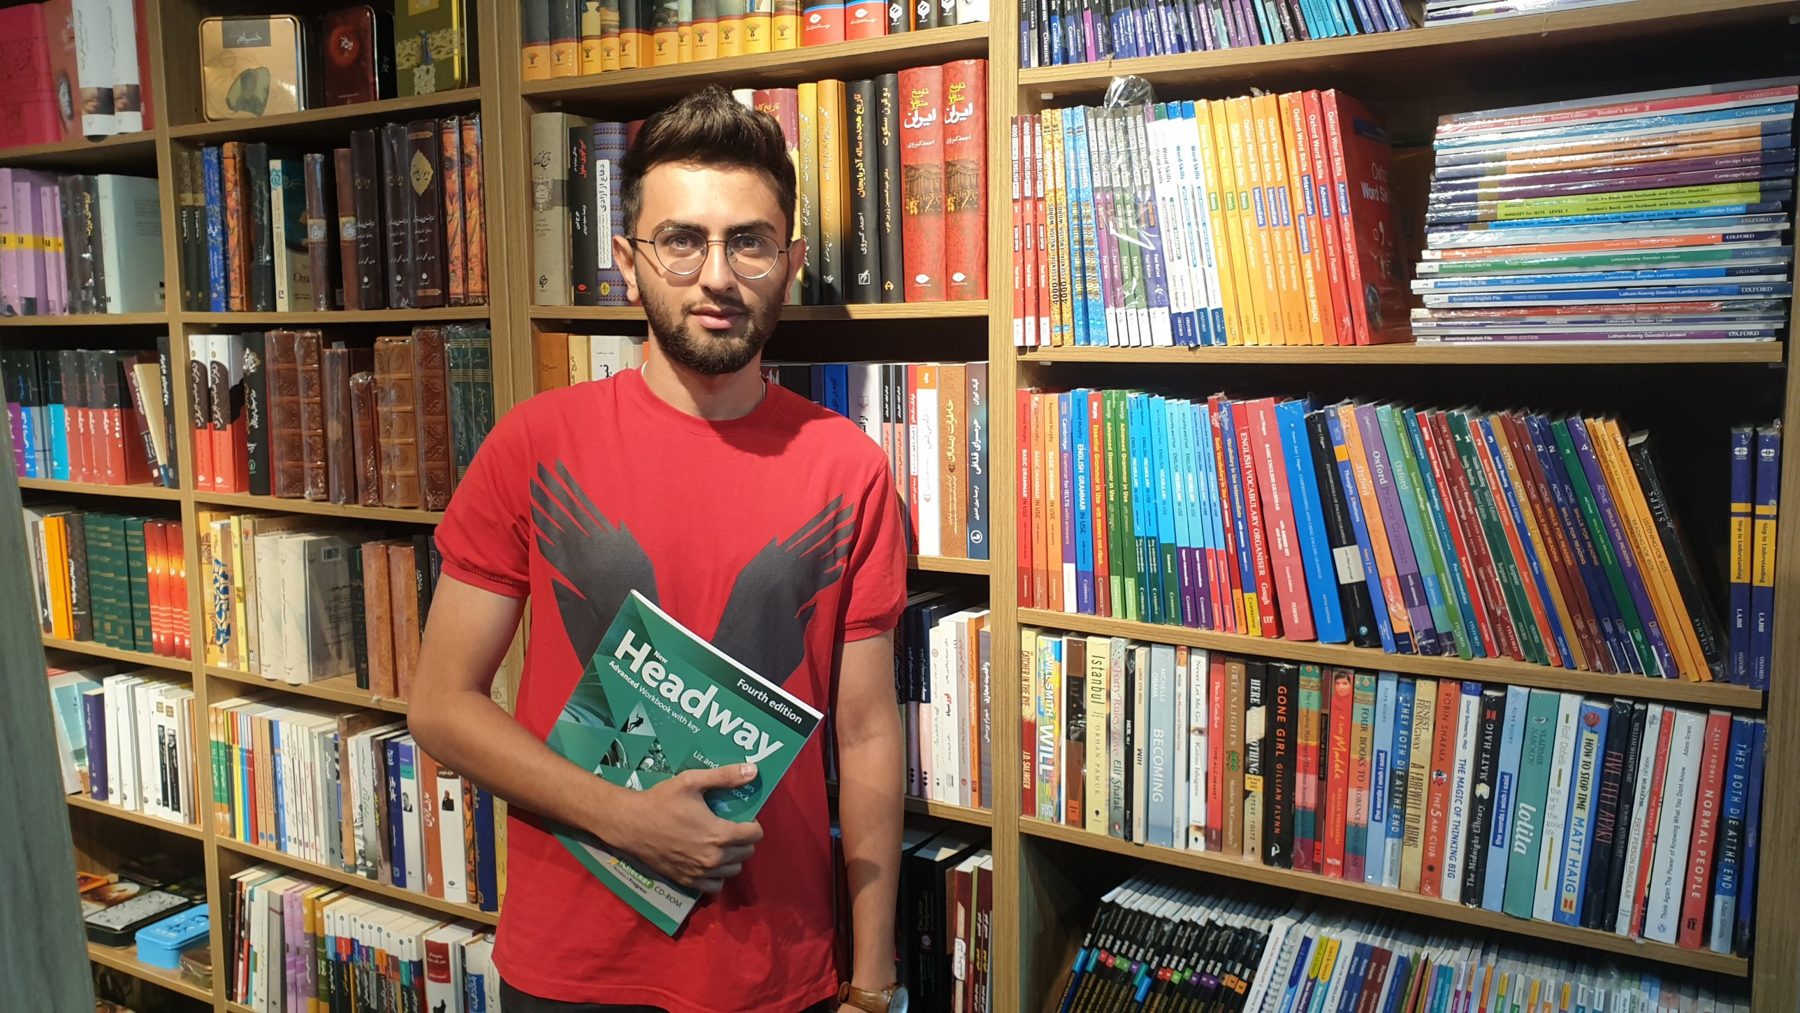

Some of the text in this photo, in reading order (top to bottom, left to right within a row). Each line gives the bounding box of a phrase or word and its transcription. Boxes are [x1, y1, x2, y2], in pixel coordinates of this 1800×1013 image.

[854, 94, 866, 114] تاریخ
[904, 107, 937, 128] ایران
[944, 101, 974, 124] ایران
[600, 164, 608, 182] دفاع
[854, 159, 866, 198] آذربایجان
[1294, 108, 1314, 215] Oxford Word Skills Intermediate
[1310, 114, 1329, 216] Oxford Word Skills Advanced
[1279, 188, 1290, 224] Intermediate
[1094, 454, 1102, 484] Grammar
[1581, 444, 1588, 452] 4
[1356, 466, 1370, 496] Oxford
[1394, 460, 1408, 490] Oxford
[1240, 432, 1266, 576] ENGLISH VOCABULARY ORGANISER
[1561, 506, 1572, 525] SKILLS
[1541, 524, 1550, 536] FOR
[1546, 538, 1559, 562] READING
[1566, 526, 1576, 538] FOR
[1573, 540, 1586, 565] READING
[1606, 508, 1616, 528] SKILLS
[1612, 528, 1620, 540] FOR
[1617, 542, 1632, 567] READING
[1643, 518, 1668, 573] LISTENING FOR IELTS
[1260, 582, 1270, 605] Gough
[654, 649, 668, 664] New
[609, 660, 701, 734] Advanced Workbook with key
[614, 628, 784, 763] Headway
[737, 678, 802, 724] Fourth edition
[1044, 656, 1054, 717] WILL SMITH
[1091, 654, 1106, 706] Istanbul
[1152, 672, 1160, 698] OBAMA
[1230, 665, 1240, 746] GREENLIGHTS
[1402, 703, 1410, 725] THEY
[1412, 699, 1424, 750] HEMINGWAY
[1421, 700, 1431, 732] ERNEST
[1438, 692, 1452, 761] ROBIN SHARMA
[693, 750, 720, 769] Liz and
[1040, 724, 1054, 777] WILL
[1274, 686, 1287, 834] GONE GIRL GILLIAN FLYNN
[1398, 730, 1408, 755] BOTH
[1480, 723, 1494, 780] MATT HAIG
[1112, 760, 1123, 811] Elif Shafak
[1152, 728, 1164, 802] BECOMING
[1354, 707, 1369, 823] FOUR BOOKS TO FLORENCE
[1394, 780, 1402, 792] AT
[1396, 760, 1406, 775] DIE
[1576, 738, 1594, 812] HOW TO STOP TIME
[1392, 792, 1402, 809] THE
[1448, 758, 1466, 878] THE MAGIC OF THINKING BIG
[1596, 750, 1624, 844] FIVE FEET APART
[1722, 743, 1746, 889] THEY BOTH DIE AT THE END
[1391, 814, 1400, 833] END
[1428, 792, 1441, 858] THE 5 AM CLUB
[1514, 802, 1537, 855] lolita
[1692, 790, 1714, 899] NORMAL PEOPLE
[1466, 804, 1486, 888] The Midnight Library
[1566, 816, 1585, 894] MATT HAIG
[1630, 836, 1640, 863] PERSON
[654, 886, 683, 909] CD-ROM
[1625, 864, 1636, 898] SINGULAR
